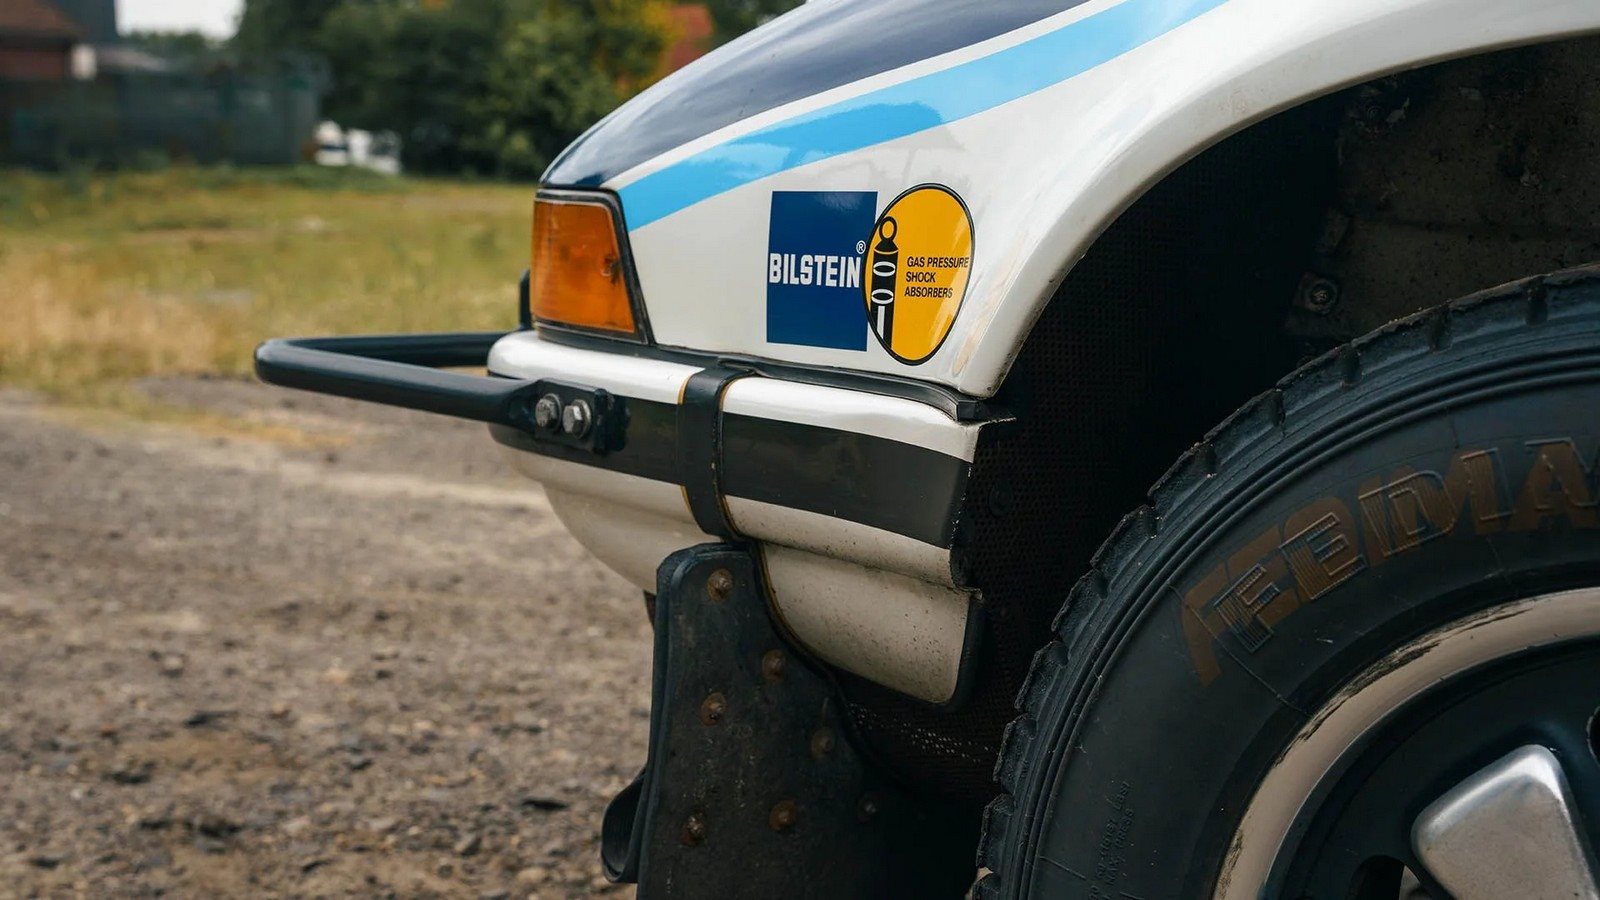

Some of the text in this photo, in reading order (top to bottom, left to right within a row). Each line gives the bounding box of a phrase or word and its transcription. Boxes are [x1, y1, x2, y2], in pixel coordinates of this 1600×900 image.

[907, 256, 970, 269] GAS PRESSURE
[769, 253, 862, 288] BILSTEIN
[905, 271, 936, 283] SHOCK
[904, 286, 954, 299] ABSORBERS
